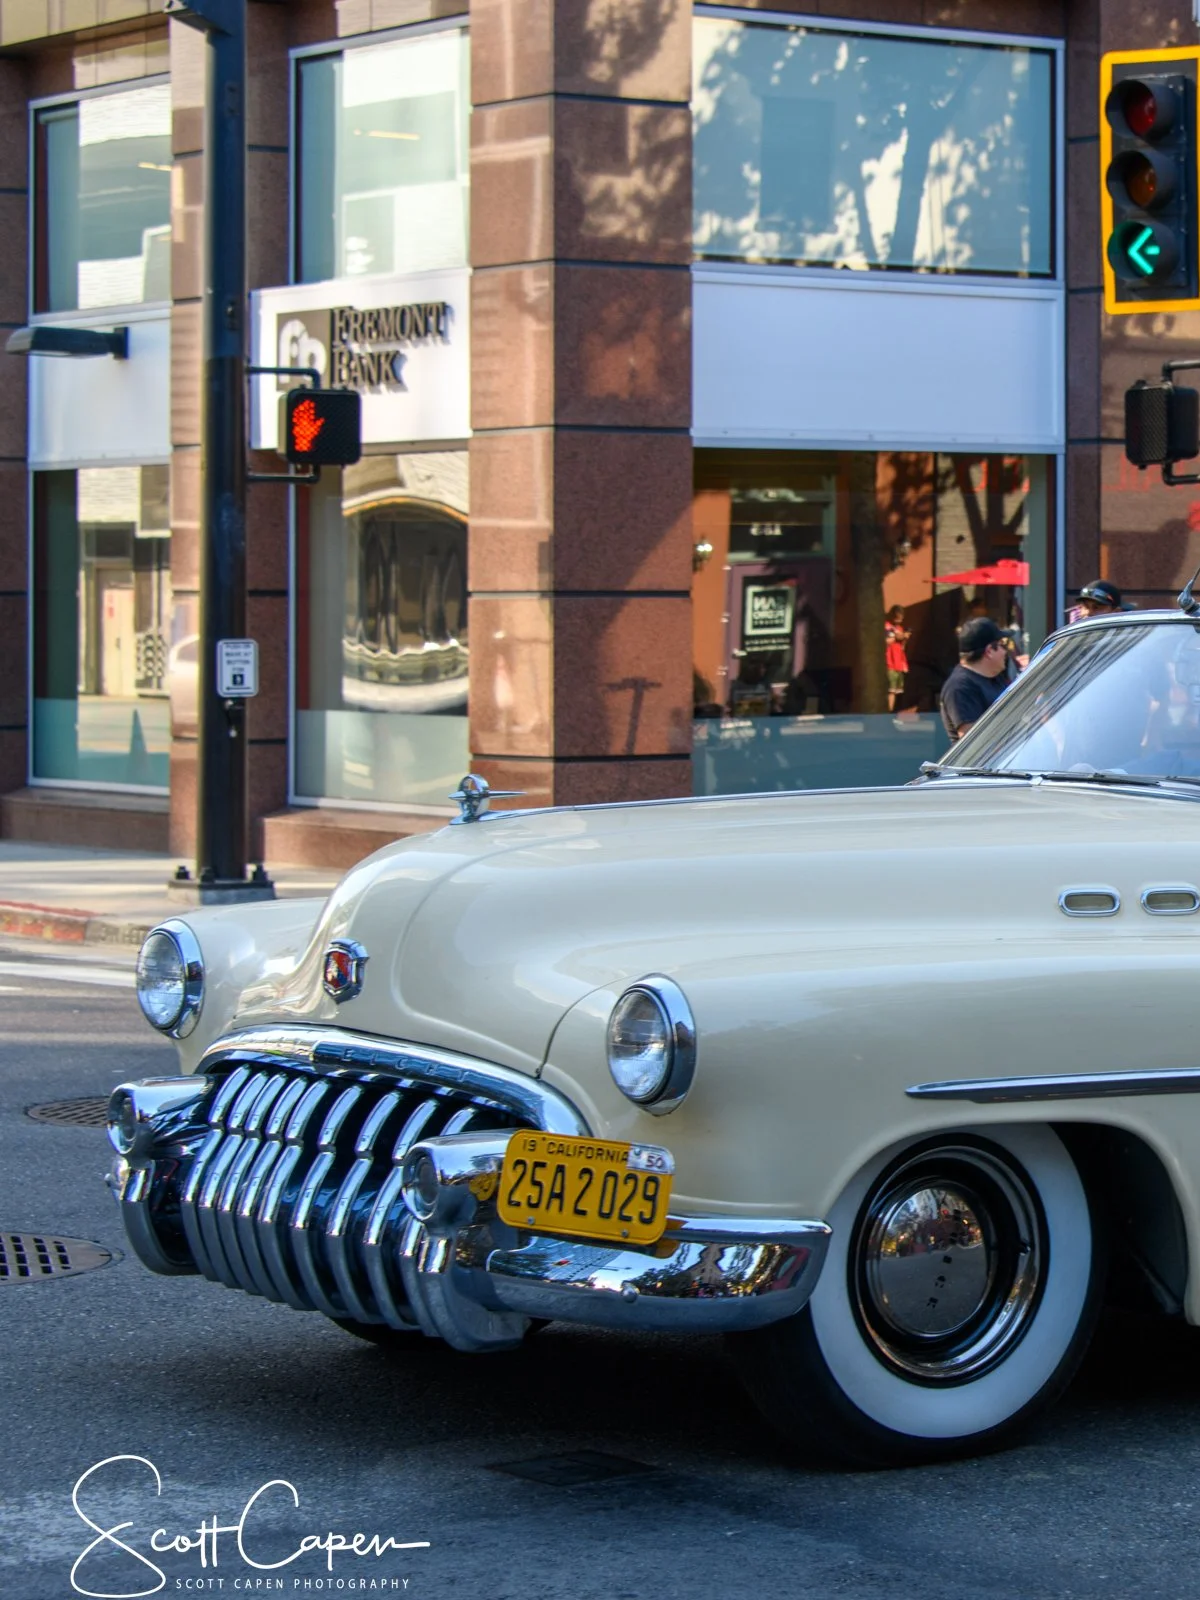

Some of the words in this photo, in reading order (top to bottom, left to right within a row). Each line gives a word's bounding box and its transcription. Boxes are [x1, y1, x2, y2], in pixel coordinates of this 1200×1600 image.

[331, 302, 447, 344] FREMONT
[332, 349, 400, 389] BANK
[523, 1138, 537, 1152] 19
[546, 1142, 629, 1164] CALIFORNIA
